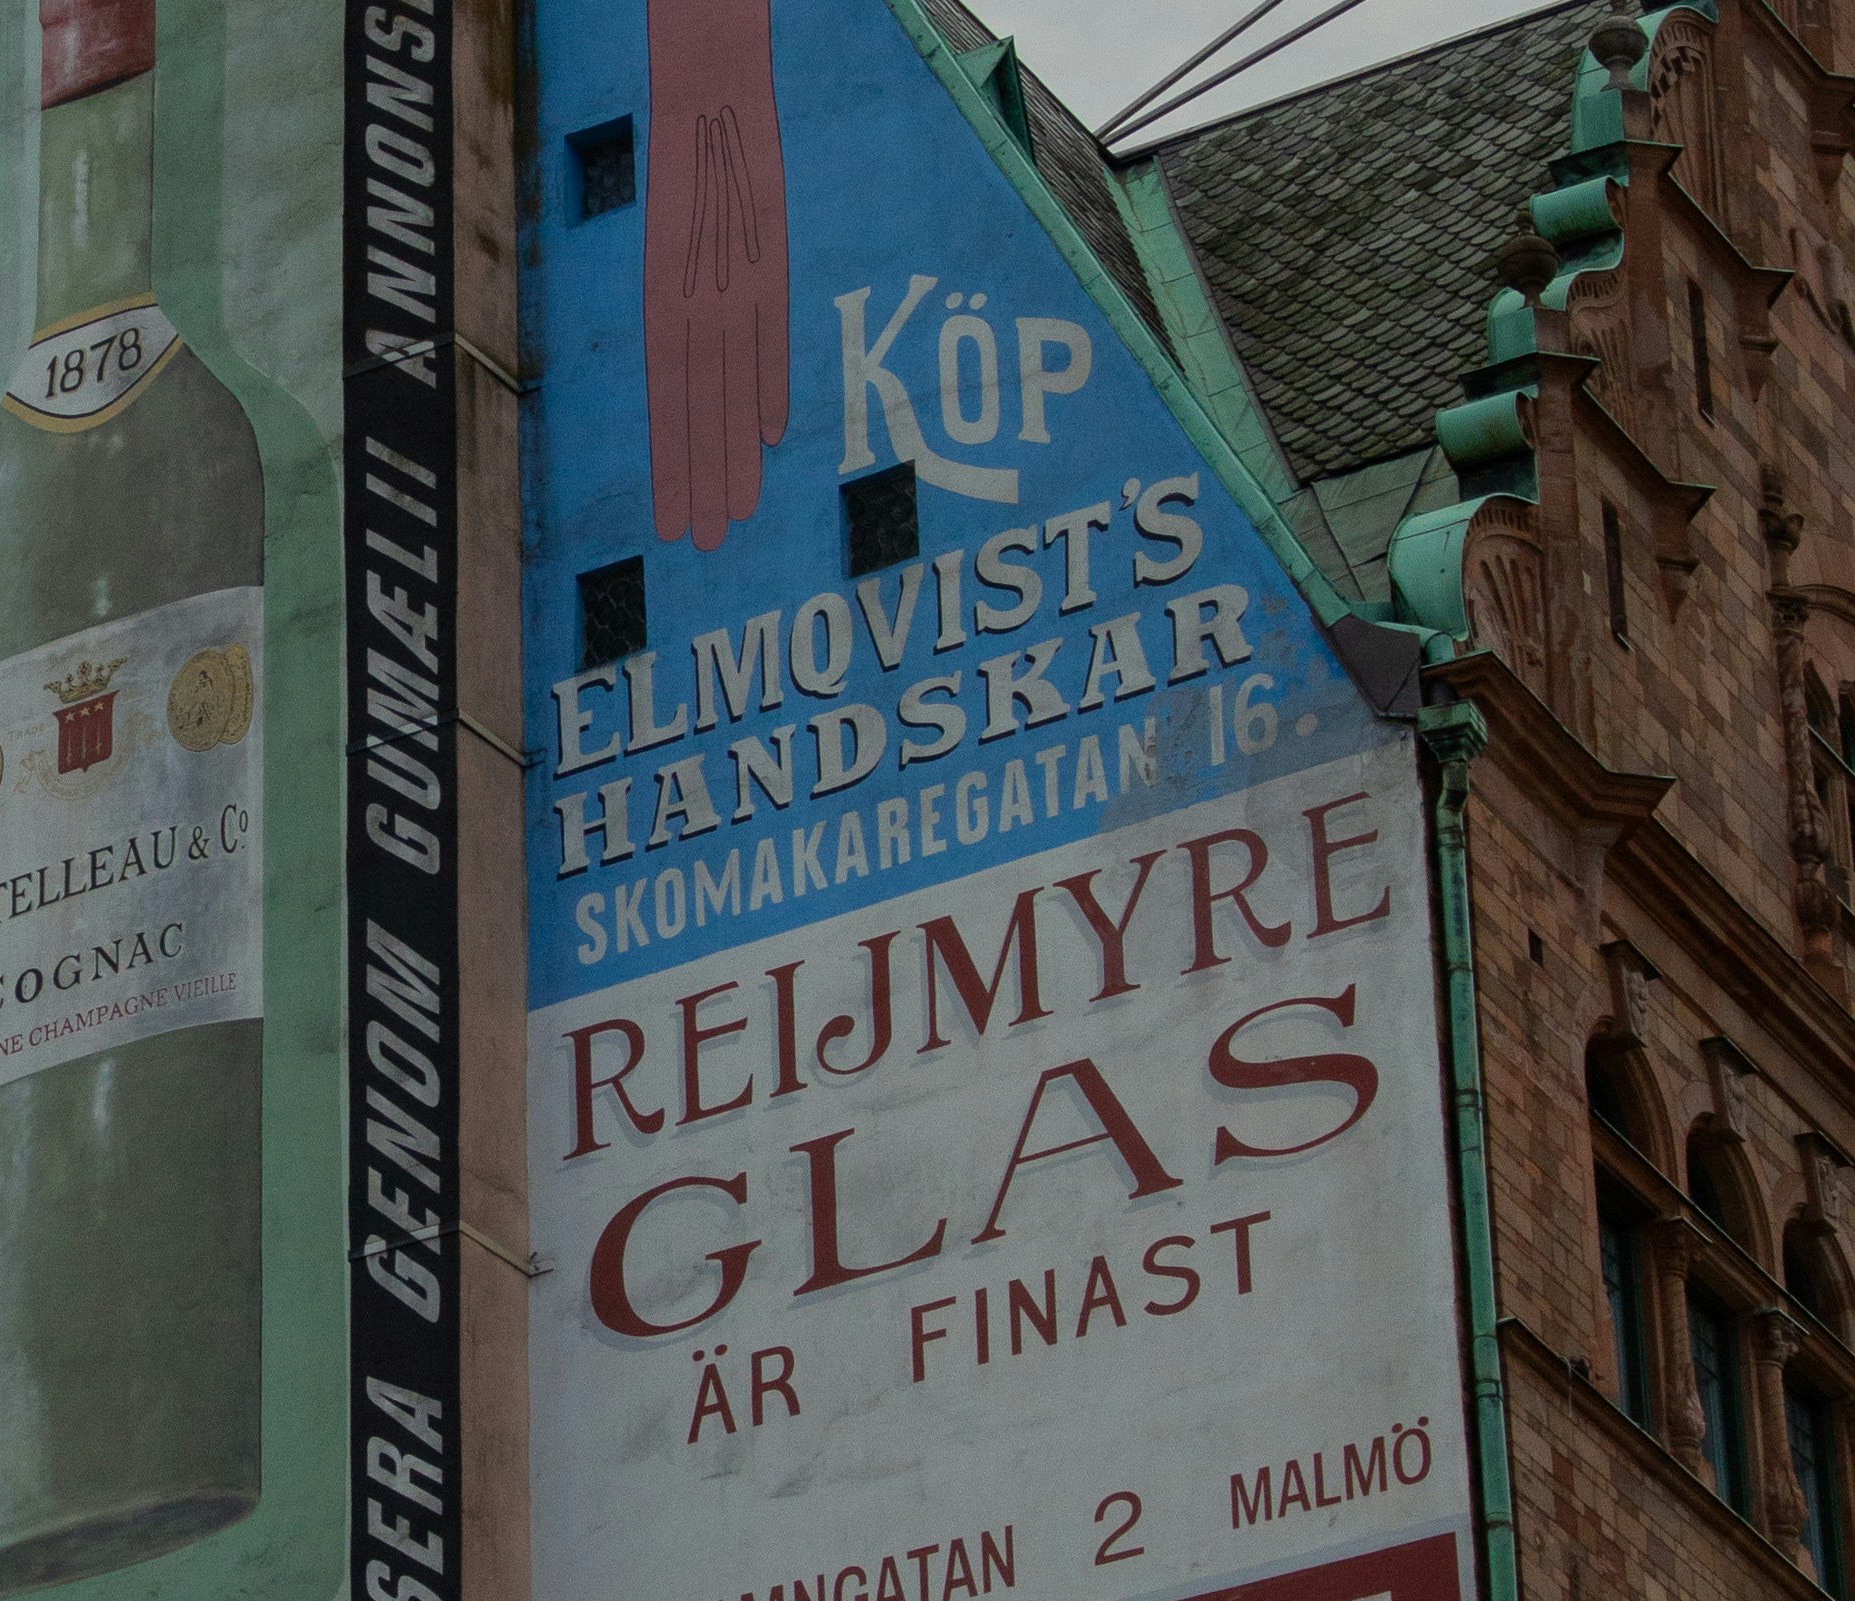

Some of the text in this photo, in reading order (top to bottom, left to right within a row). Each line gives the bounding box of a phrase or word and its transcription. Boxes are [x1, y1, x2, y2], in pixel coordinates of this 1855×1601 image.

[43, 326, 144, 400] 1878
[834, 274, 1093, 504] KÖP
[551, 473, 1204, 780] ELMQVIST'S
[555, 584, 1253, 880] HANDSKAR
[187, 825, 211, 861] &
[576, 716, 1157, 966] SKOMAKAREGATAN
[29, 988, 169, 1047] CHAMPAGNE
[173, 971, 238, 1002] VIEILLE
[562, 791, 1391, 1162] REIJMYRE
[365, 918, 441, 1324] GENOM
[589, 984, 1380, 1338] GLAS
[687, 1212, 1271, 1444] ÄR FINAST
[1093, 1490, 1145, 1567] 2
[1229, 1417, 1432, 1530] MALMÖ
